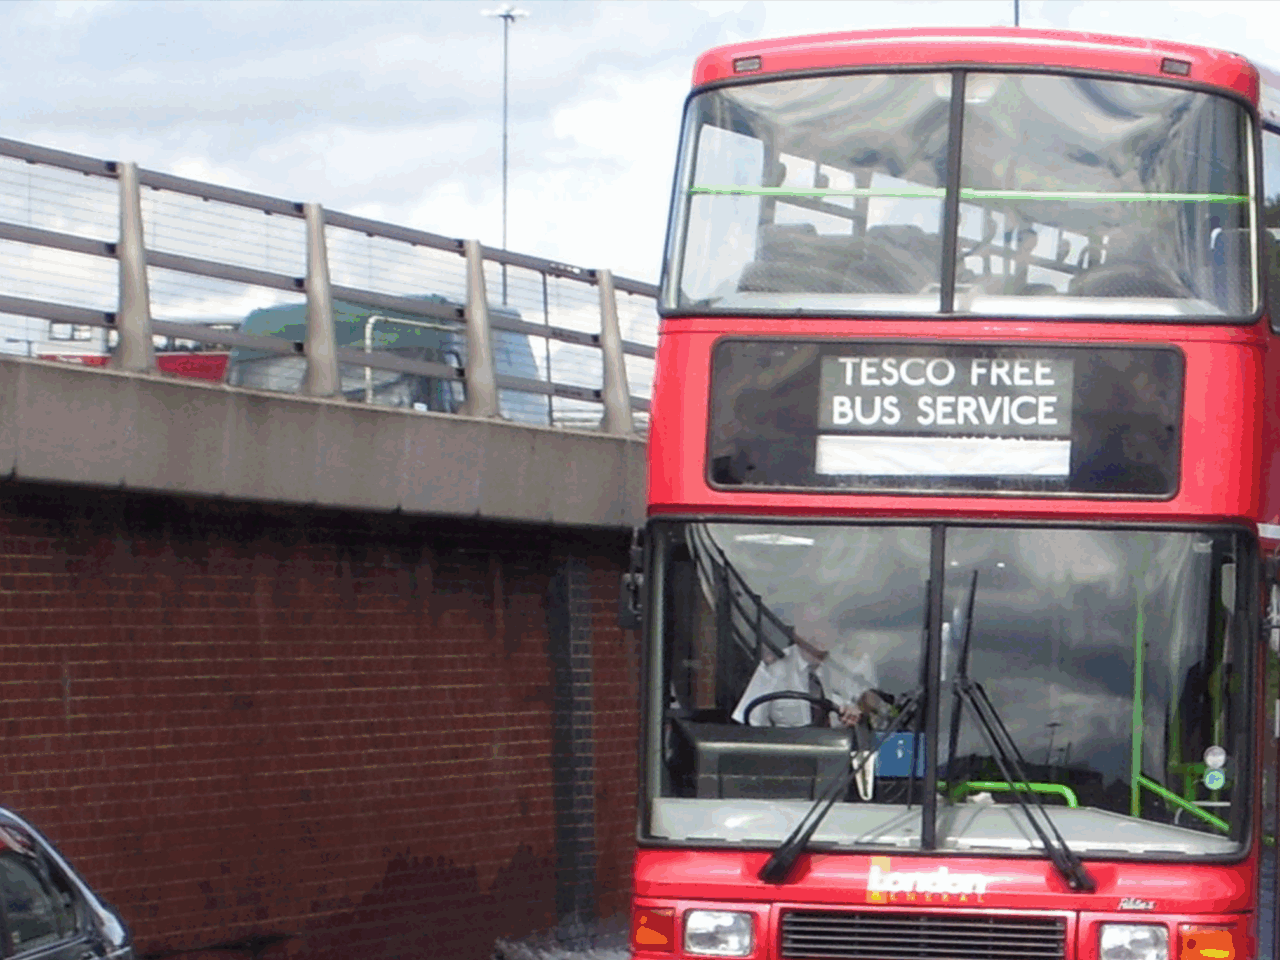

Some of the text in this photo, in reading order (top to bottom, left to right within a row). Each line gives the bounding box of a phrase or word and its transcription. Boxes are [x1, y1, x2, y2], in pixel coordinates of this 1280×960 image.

[838, 357, 1055, 387] TESCO FREE
[831, 395, 1058, 427] BUS SERVICE
[867, 864, 988, 893] London
